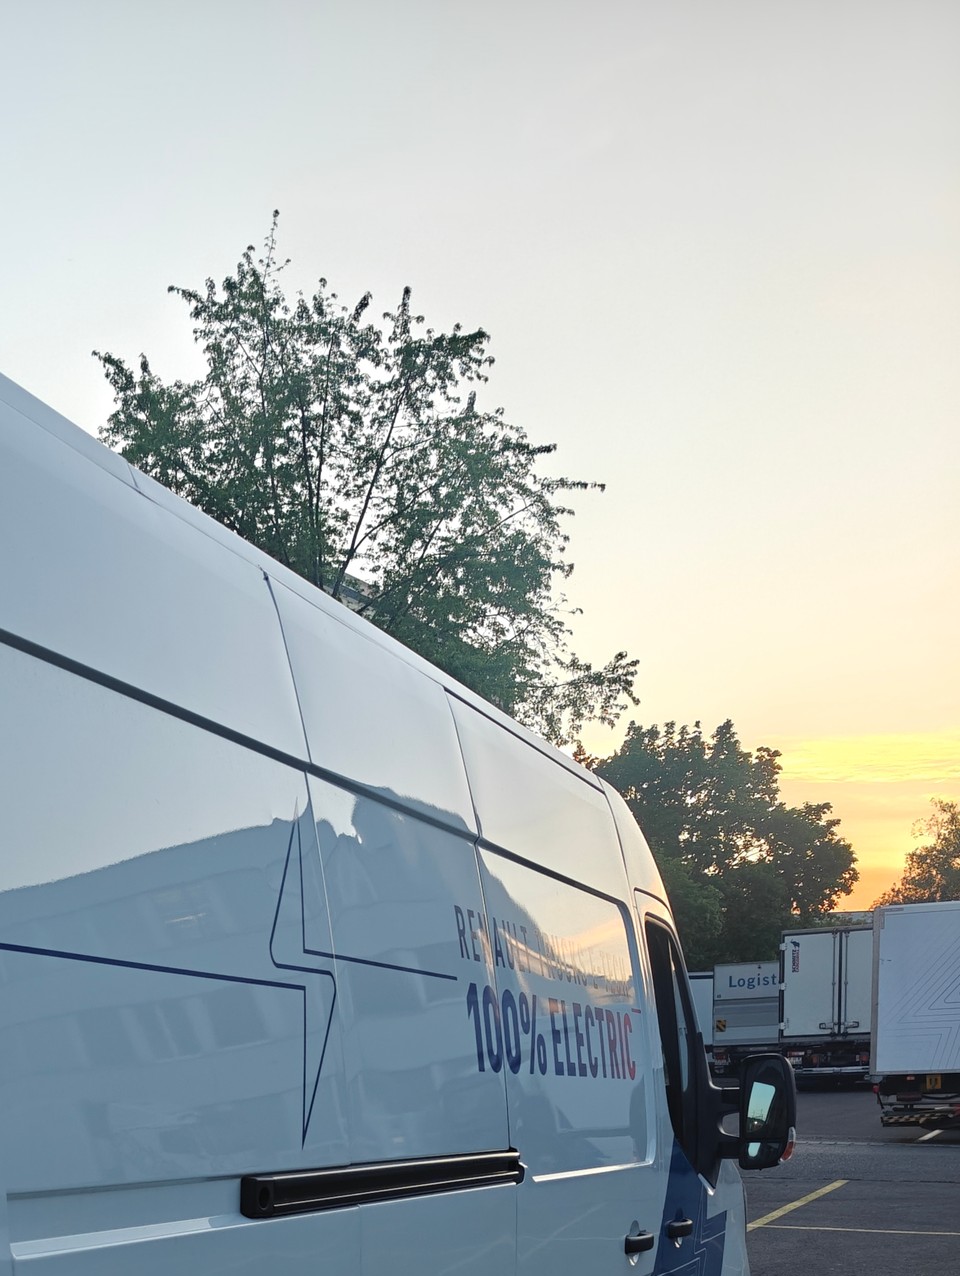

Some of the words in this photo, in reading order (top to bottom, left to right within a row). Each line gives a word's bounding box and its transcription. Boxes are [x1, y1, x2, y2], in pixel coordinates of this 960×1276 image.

[454, 904, 531, 974] RENAULT
[729, 973, 777, 990] Logist
[466, 982, 547, 1076] 100%
[548, 997, 636, 1081] ELECTRIC
